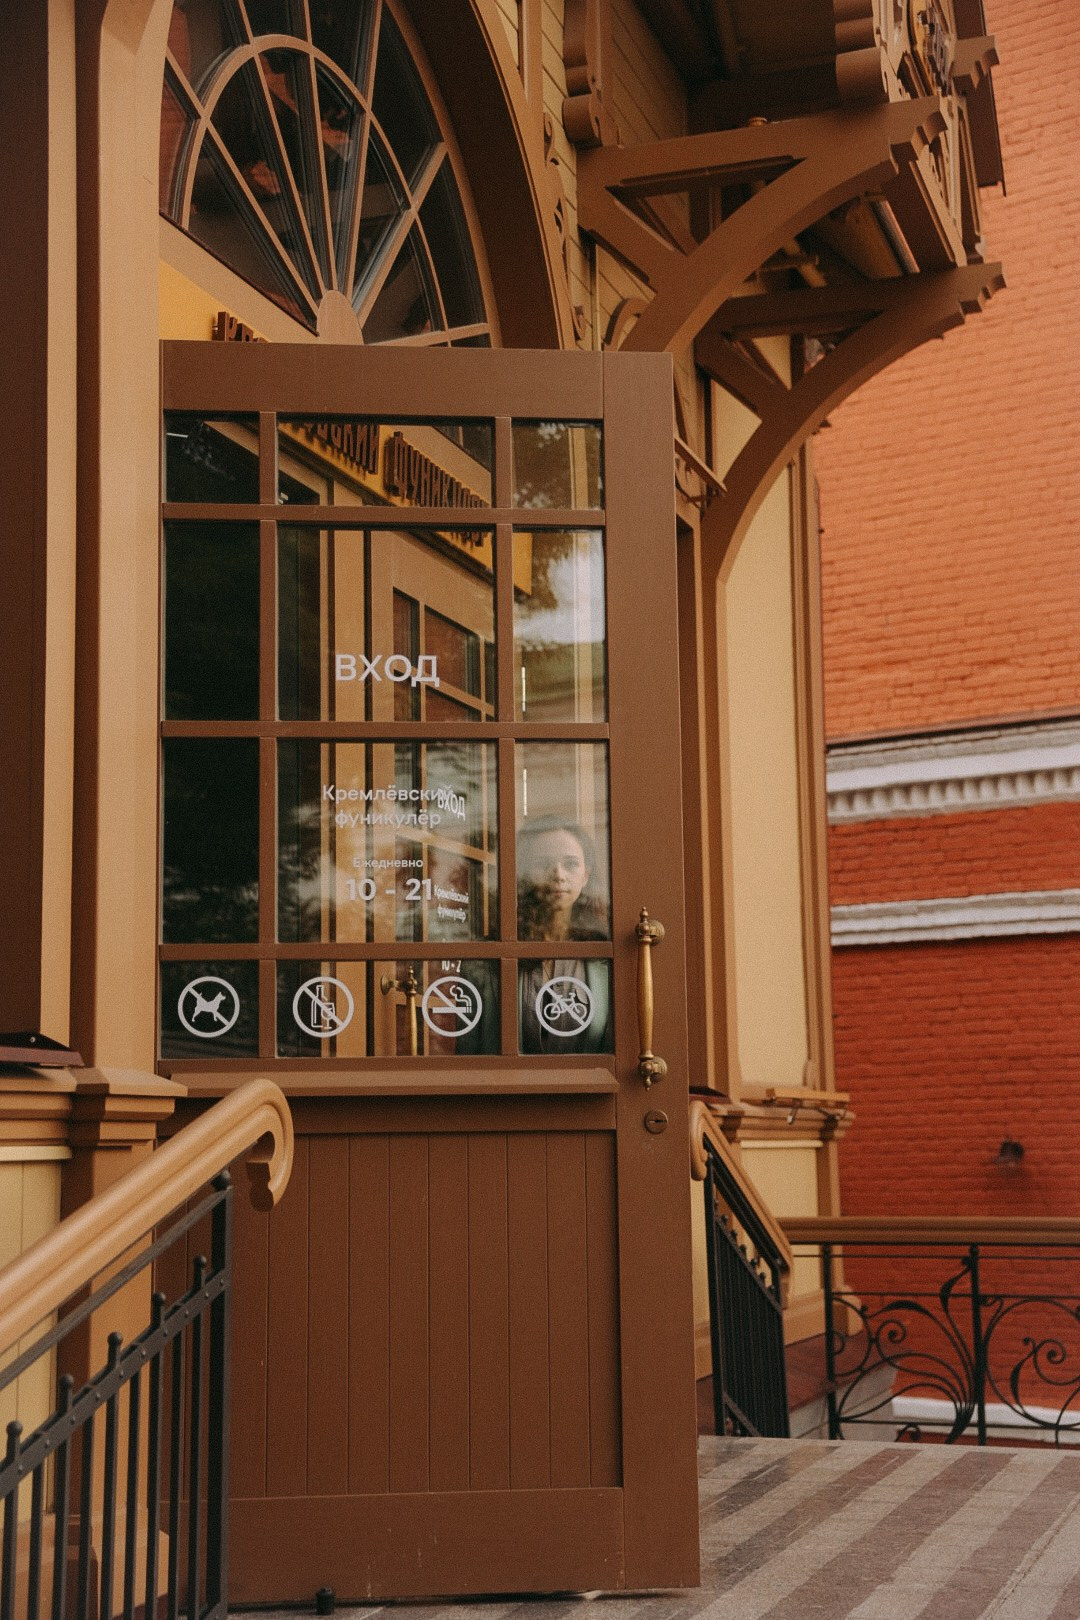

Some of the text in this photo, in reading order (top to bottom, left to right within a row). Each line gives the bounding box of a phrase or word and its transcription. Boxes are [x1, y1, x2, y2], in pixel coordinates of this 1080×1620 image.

[335, 654, 440, 687] ВХОД
[335, 808, 441, 828] фуникулёр
[353, 857, 424, 869] Ежедневно
[346, 878, 376, 900] 10
[405, 878, 432, 900] 21
